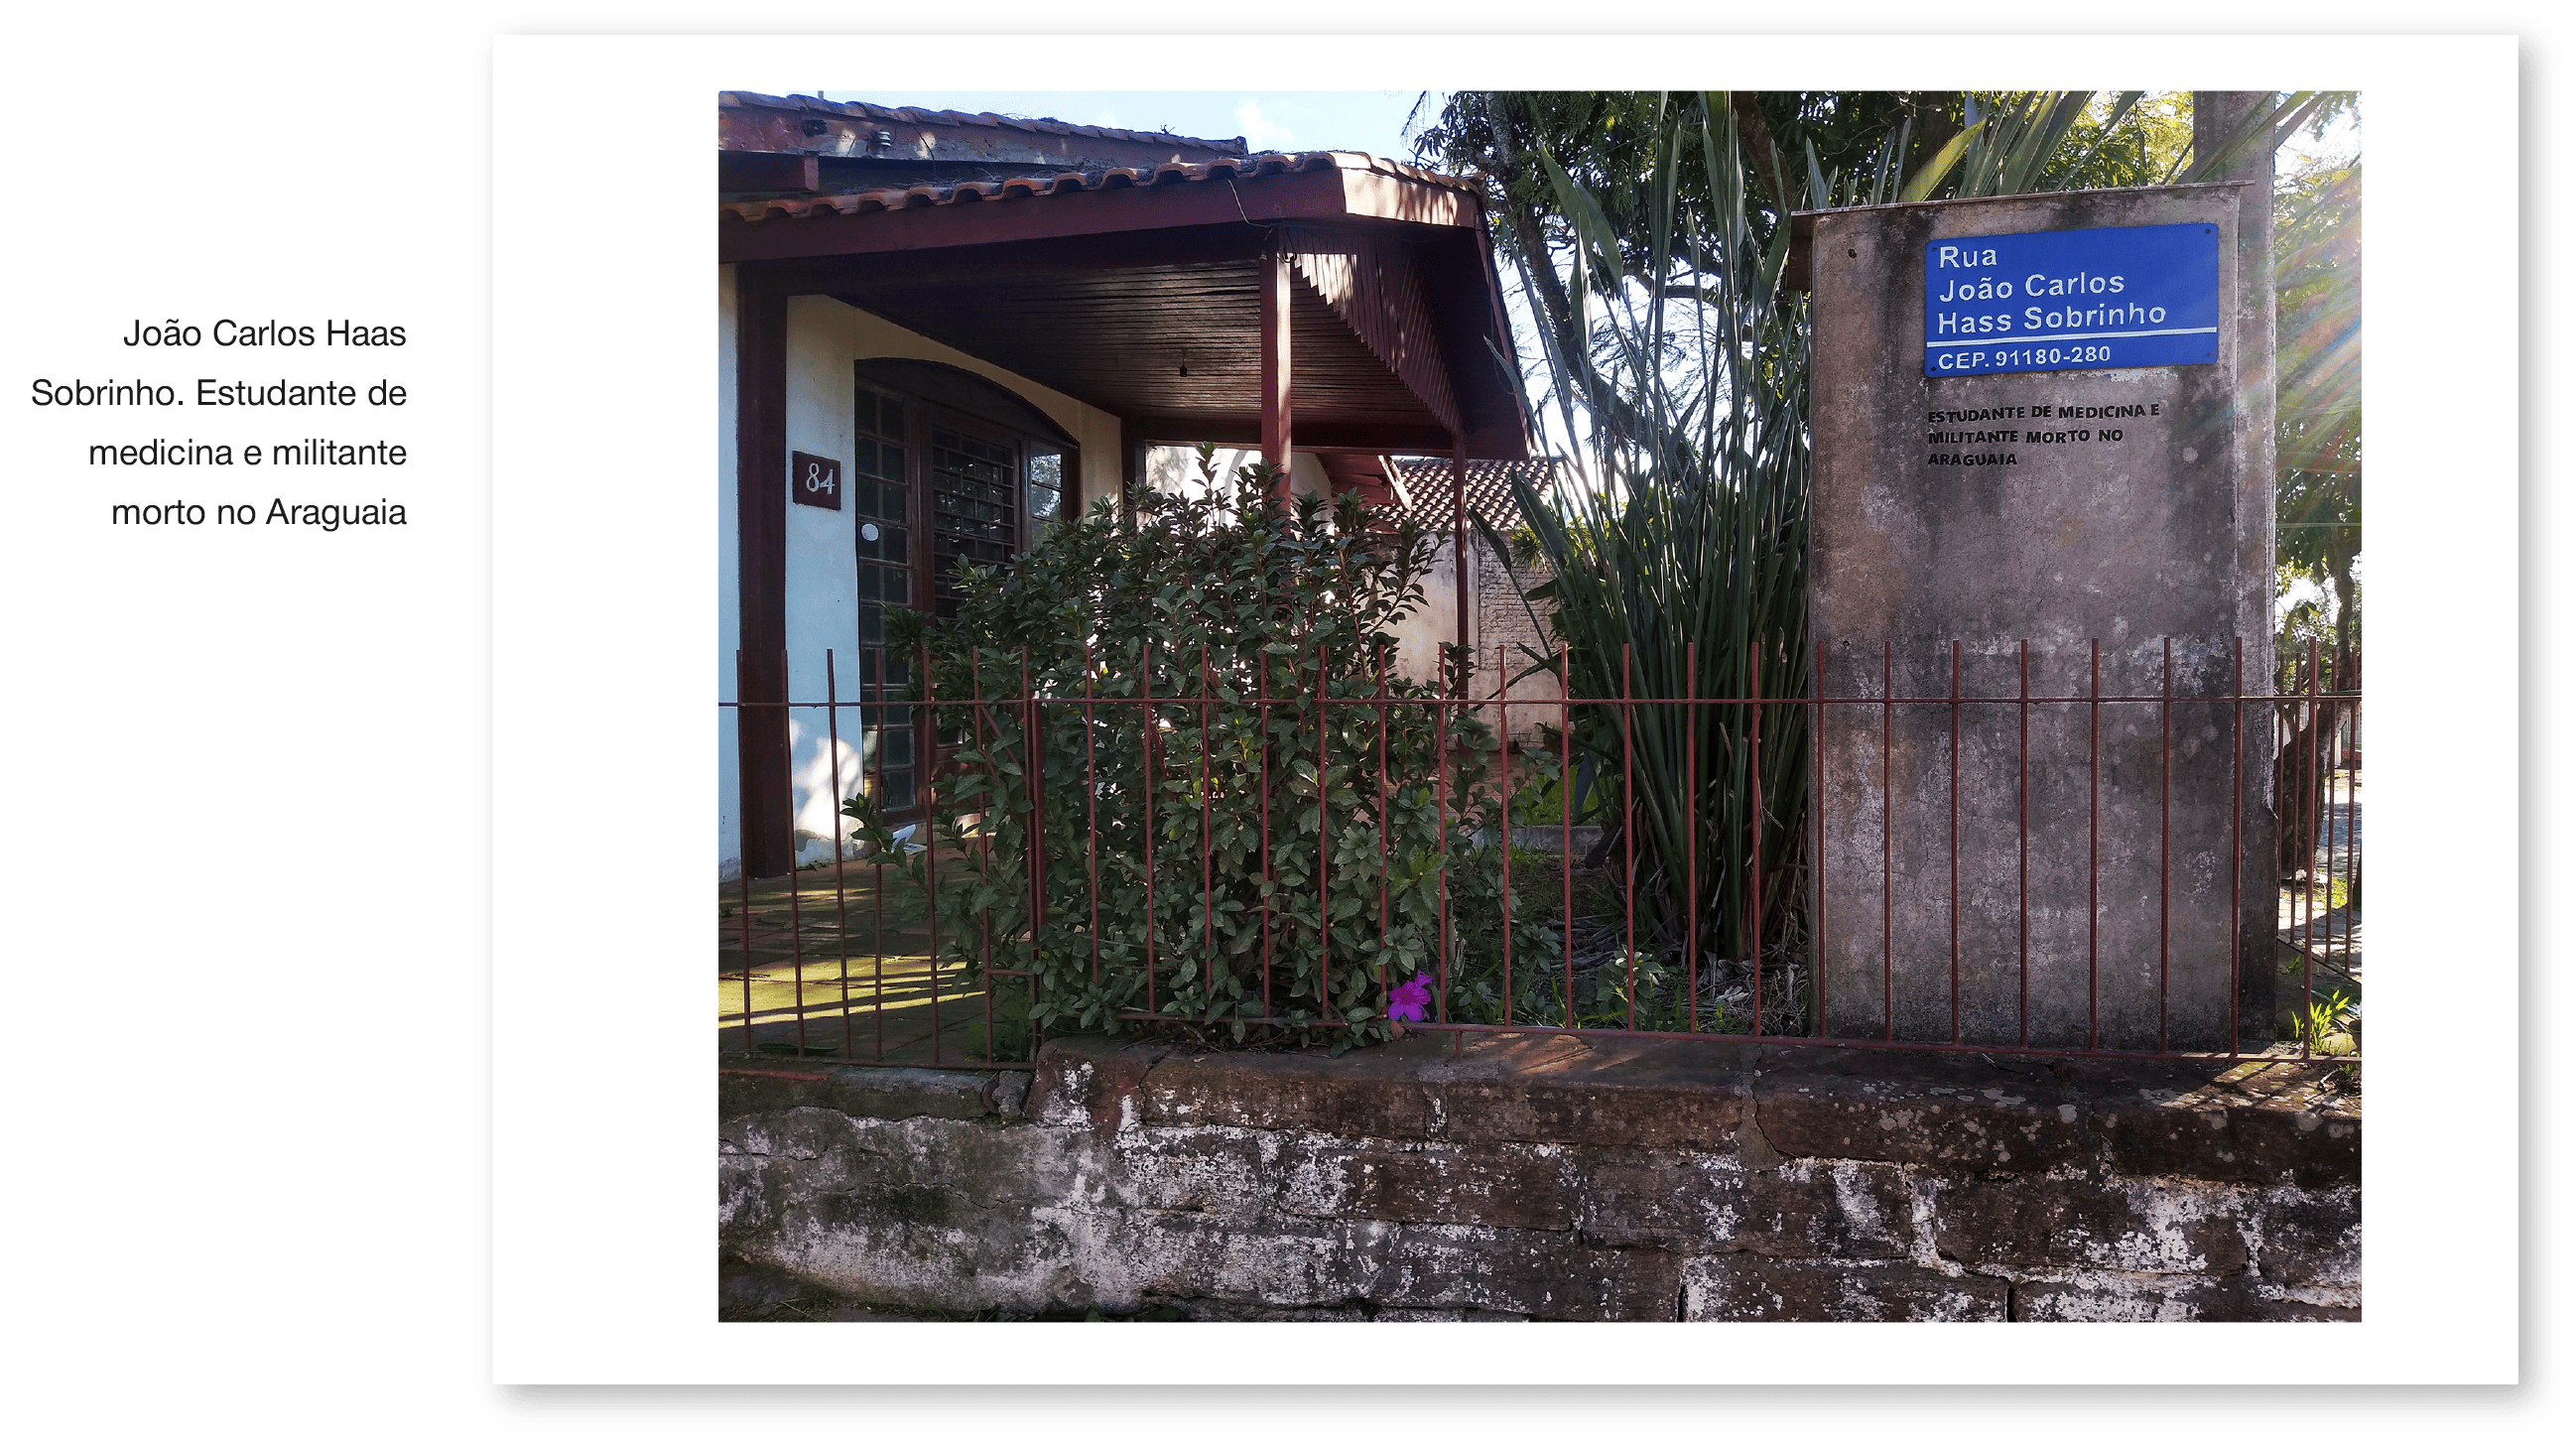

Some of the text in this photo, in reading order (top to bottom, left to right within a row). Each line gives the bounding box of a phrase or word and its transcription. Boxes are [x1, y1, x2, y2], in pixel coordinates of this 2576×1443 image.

[1940, 246, 1997, 269] Rua
[1940, 272, 2125, 302] João Carlos
[1938, 303, 2166, 334] Hass Sobrinho
[1938, 346, 2111, 369] CEP. 91180-280
[1928, 404, 2160, 423] ESTUDANTE DE MEDICINA E
[1928, 429, 2124, 445] MILITANTE MORTO NO
[1928, 454, 2017, 466] ARAGUAIA
[806, 462, 836, 495] 84
